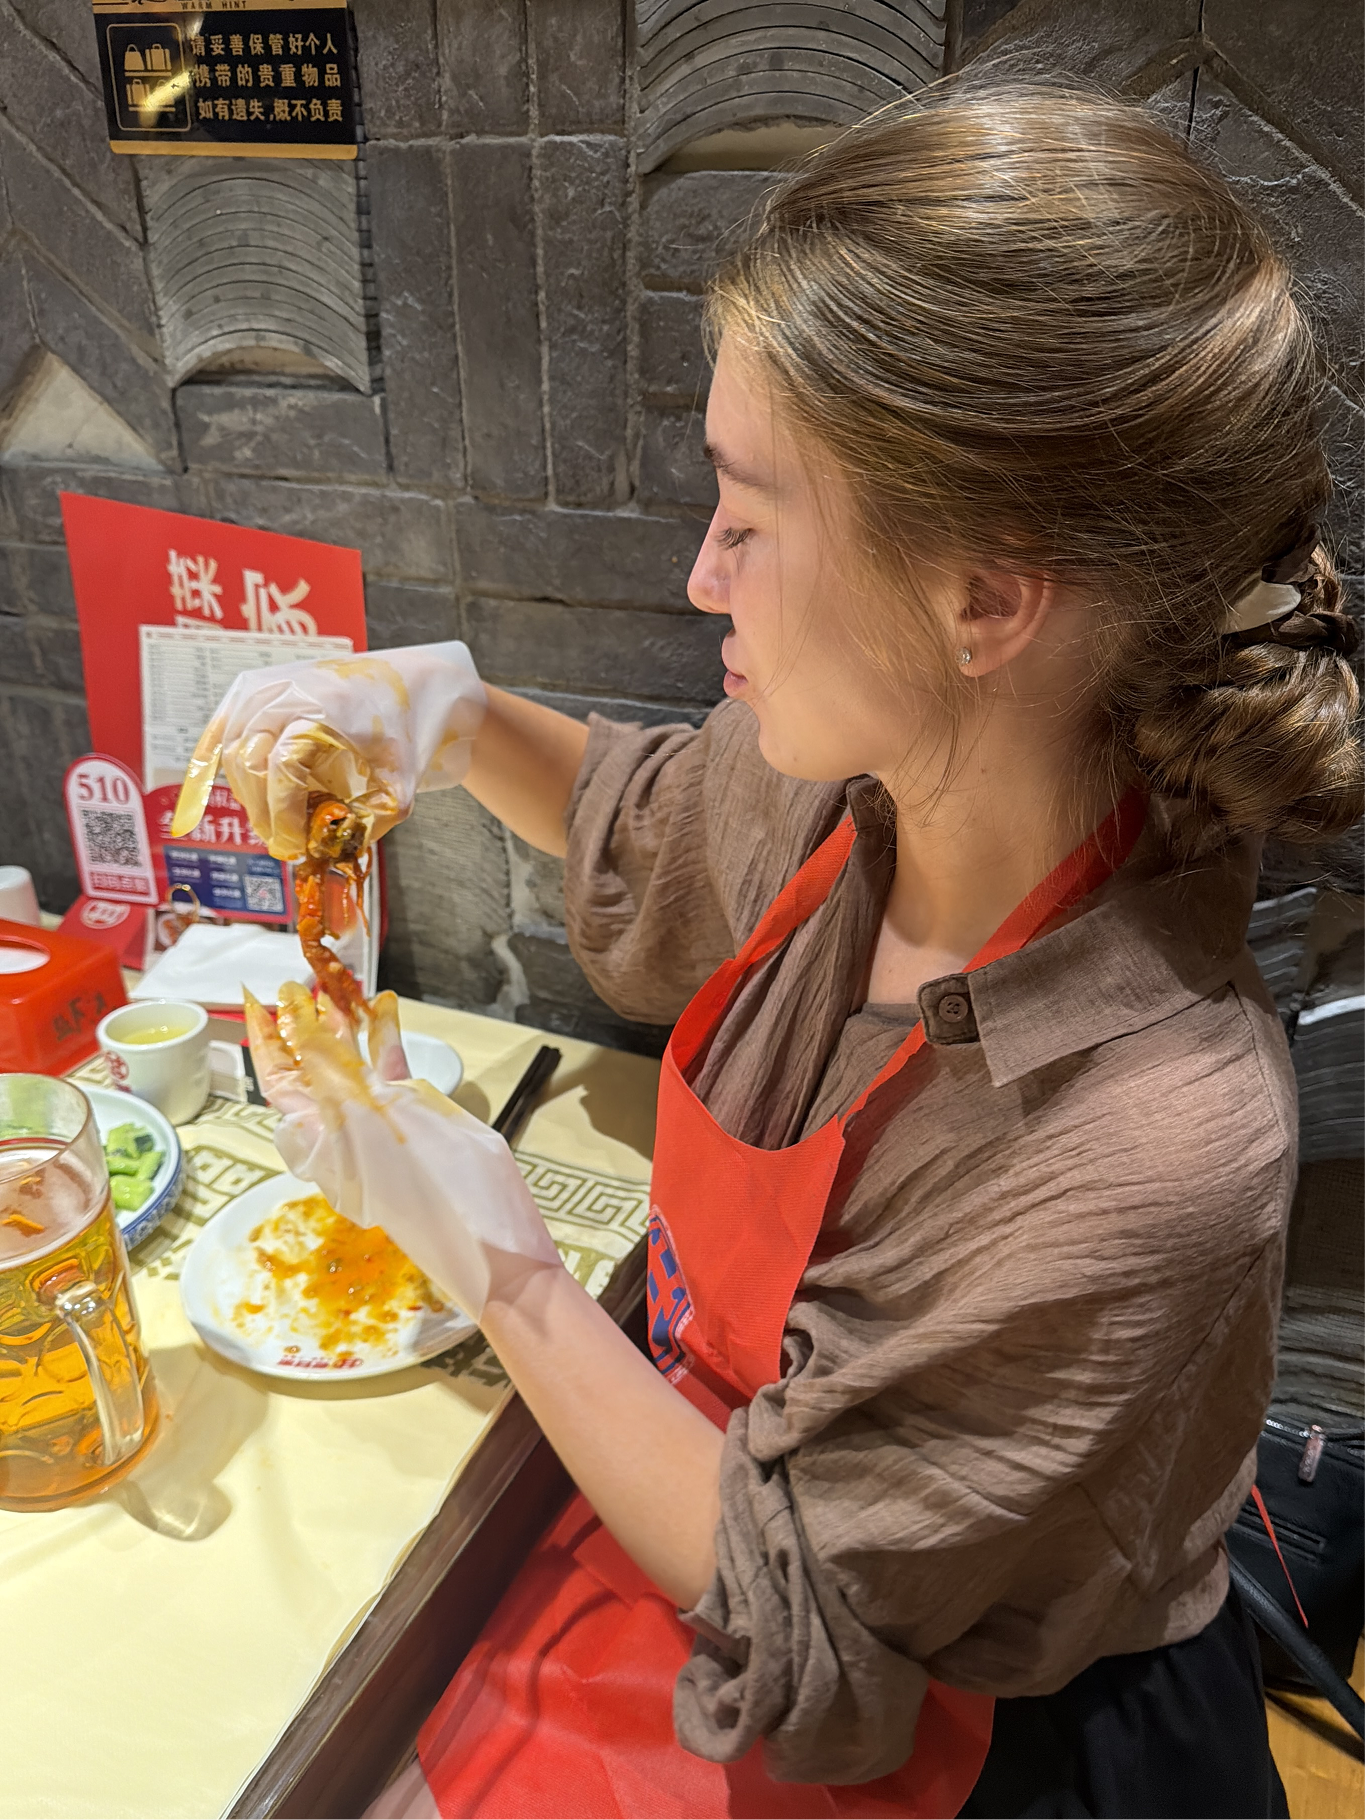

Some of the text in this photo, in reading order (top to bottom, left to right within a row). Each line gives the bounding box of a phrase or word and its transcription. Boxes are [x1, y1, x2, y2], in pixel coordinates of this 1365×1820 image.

[181, 1, 212, 10] WARM
[222, 0, 247, 9] HINT
[191, 32, 337, 56] 请妥善保管好个人
[194, 63, 341, 87] 携带的贵重物品
[167, 548, 225, 630] 菜
[76, 771, 130, 806] 510
